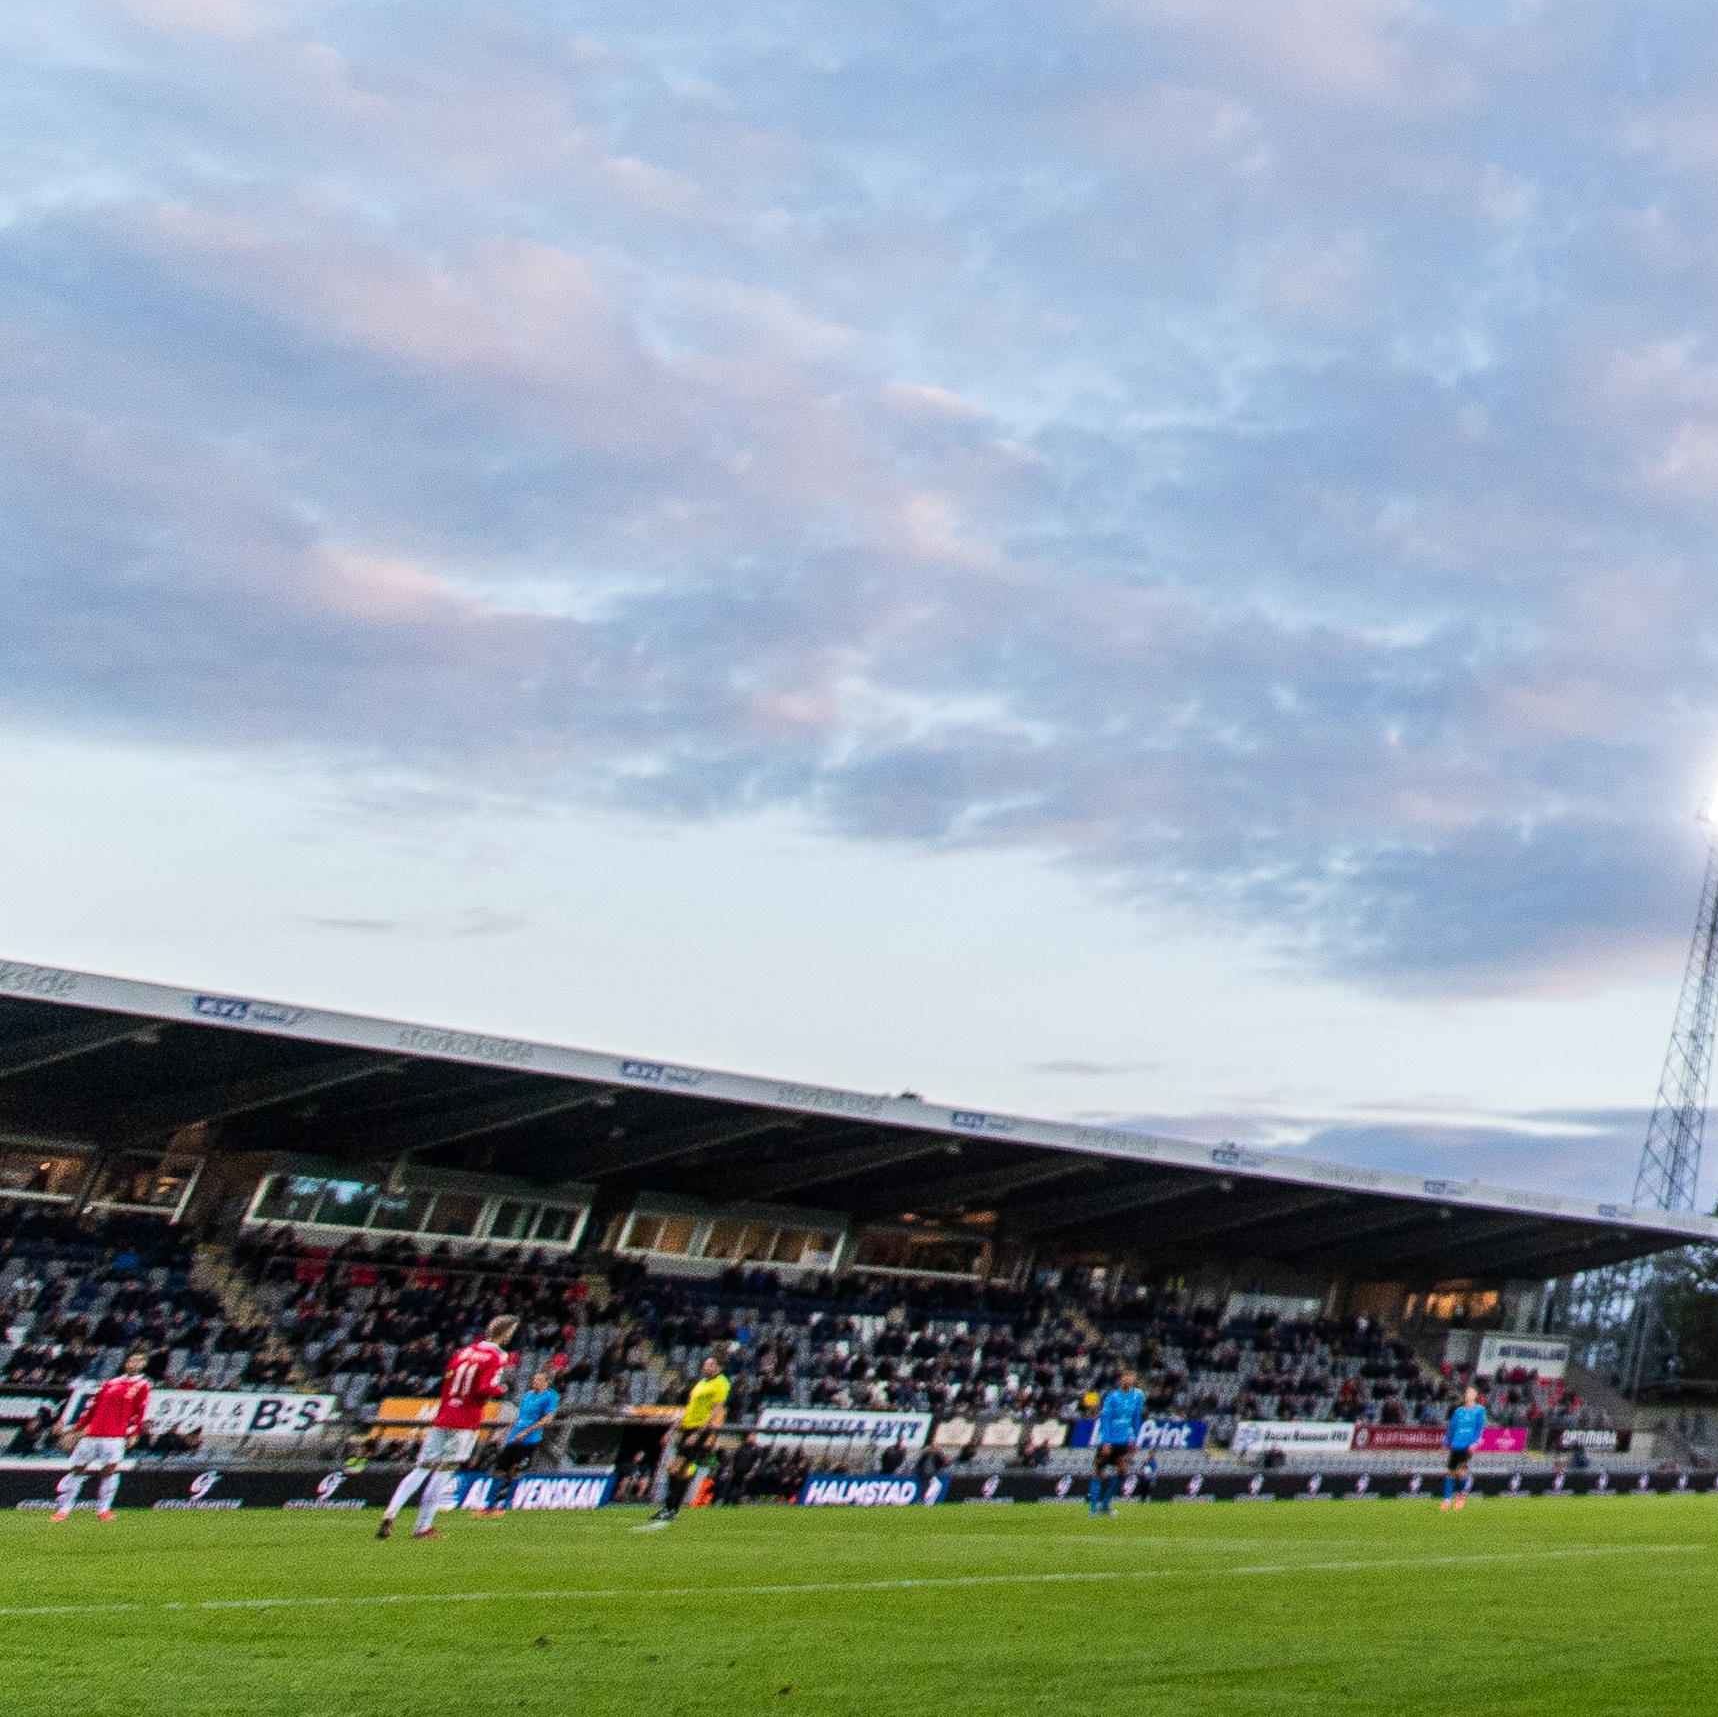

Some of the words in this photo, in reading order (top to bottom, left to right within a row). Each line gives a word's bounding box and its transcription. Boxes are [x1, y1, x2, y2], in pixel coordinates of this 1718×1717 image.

[450, 1362, 480, 1397] 11
[155, 1396, 227, 1418] STÅL
[250, 1399, 322, 1431] B:S
[1138, 1419, 1191, 1449] Print
[461, 1477, 607, 1511] ALVENSKAN
[805, 1479, 918, 1506] HALMSTAD
